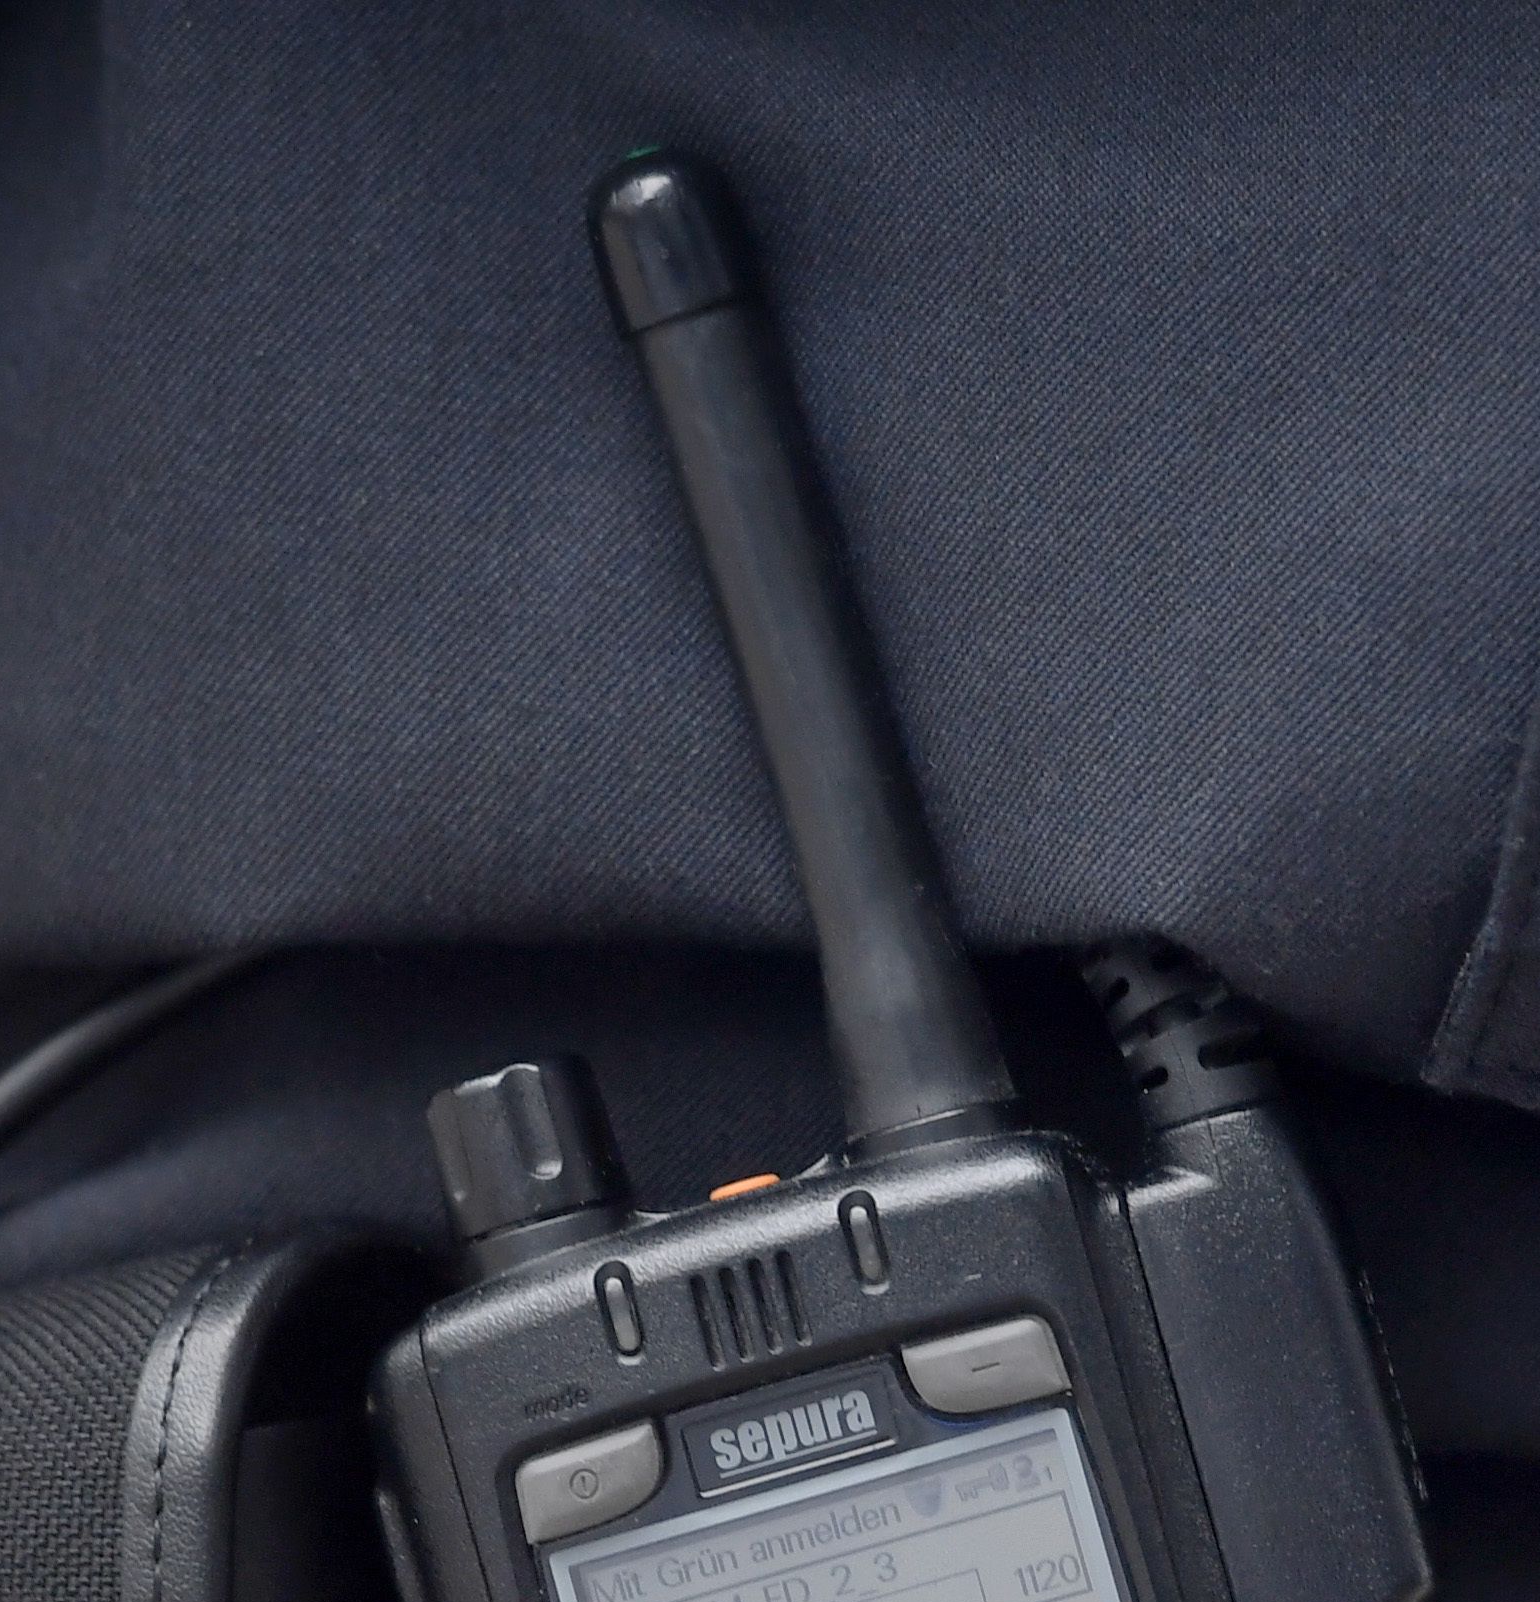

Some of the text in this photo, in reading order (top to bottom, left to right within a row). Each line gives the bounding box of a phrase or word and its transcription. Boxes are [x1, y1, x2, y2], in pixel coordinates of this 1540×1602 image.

[710, 1390, 877, 1470] sepura
[658, 1549, 739, 1588] Grün
[749, 1502, 903, 1564] anmelden
[1014, 1554, 1082, 1600] 1120
